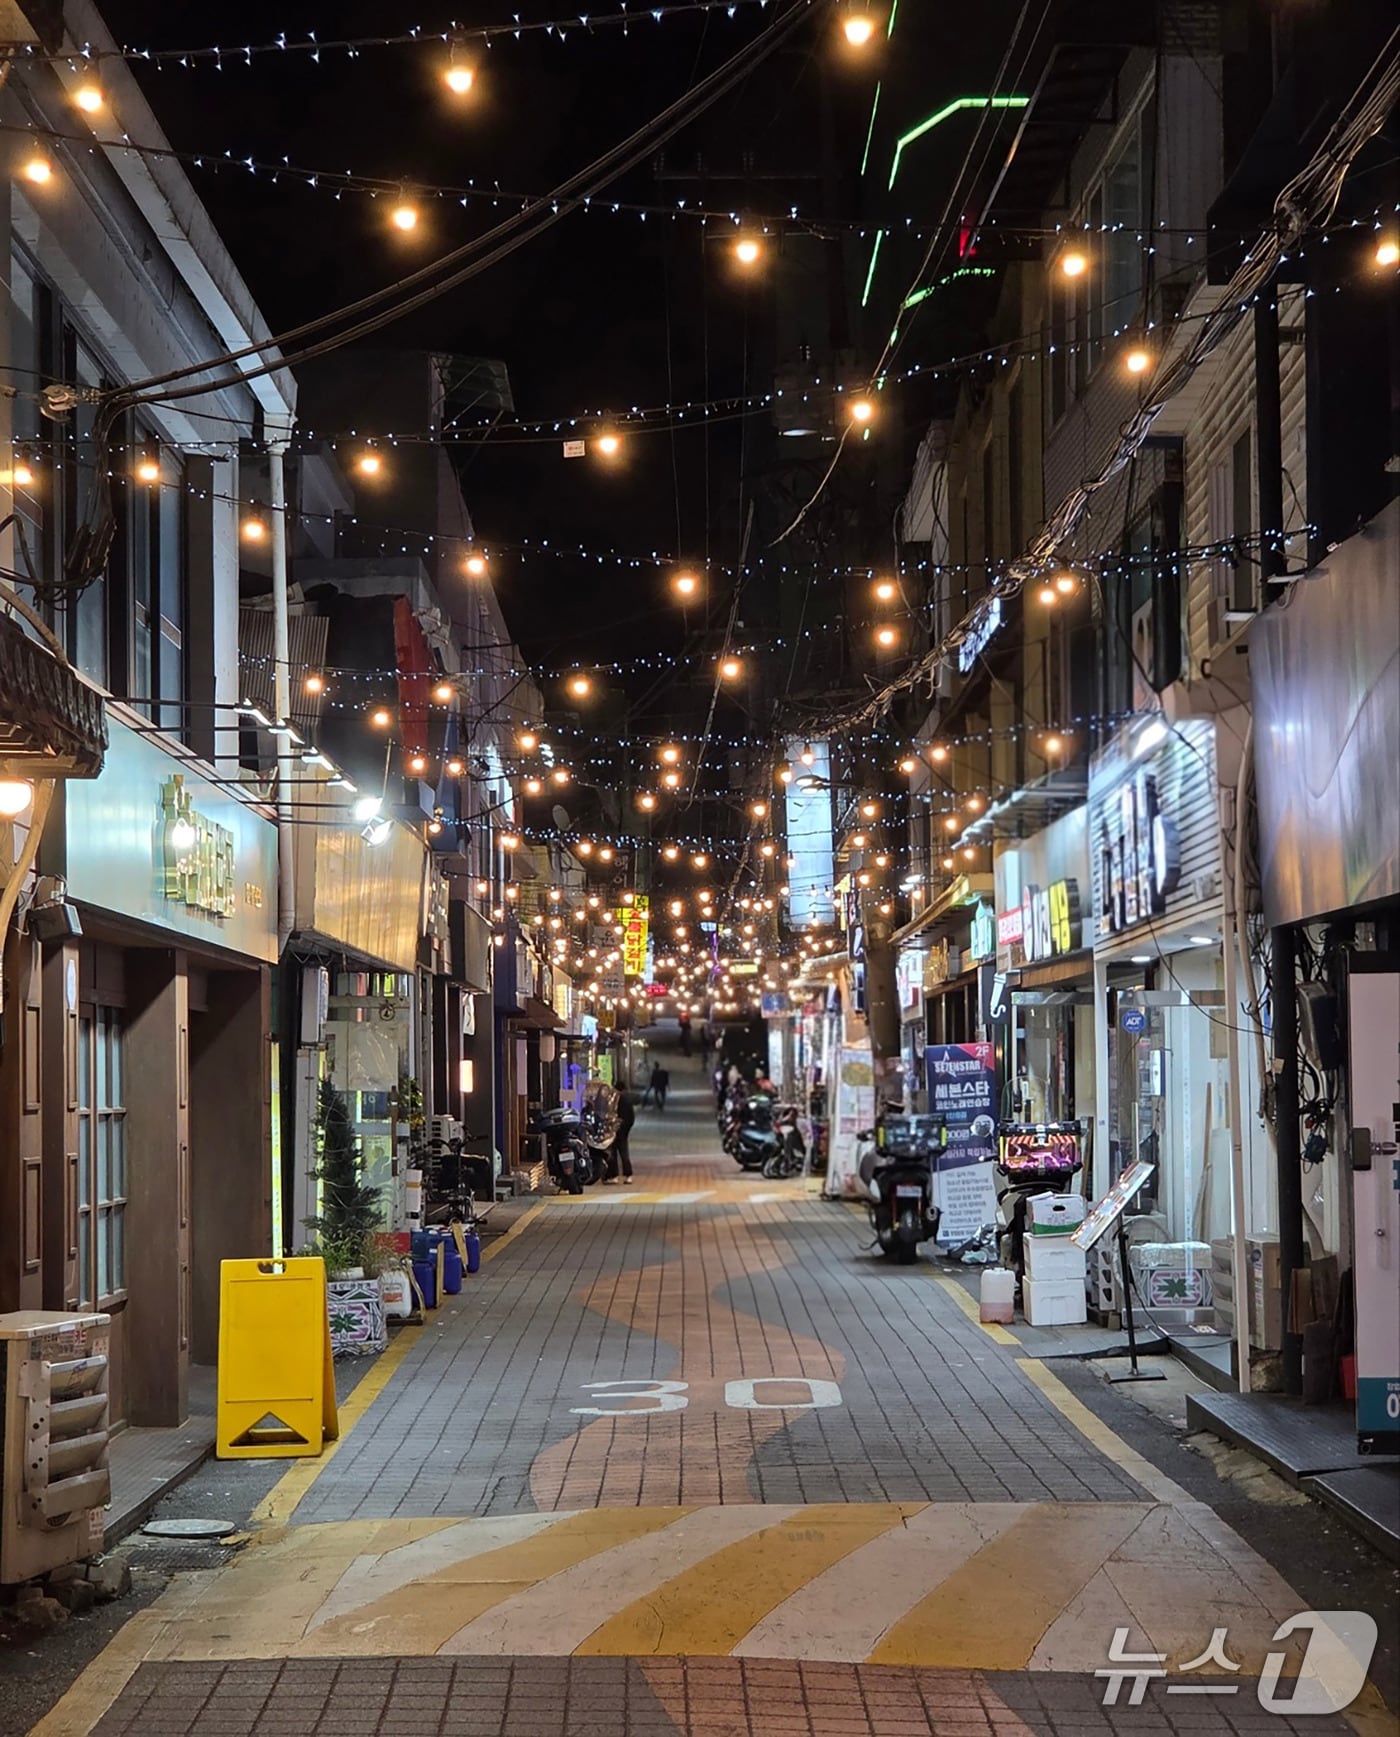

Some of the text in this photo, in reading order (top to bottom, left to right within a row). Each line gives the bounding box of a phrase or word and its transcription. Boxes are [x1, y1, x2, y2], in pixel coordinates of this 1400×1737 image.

[1125, 1016, 1142, 1026] ADT
[975, 1045, 989, 1057] 2F
[935, 1080, 990, 1099] 세븐스타
[568, 1378, 843, 1415] 30
